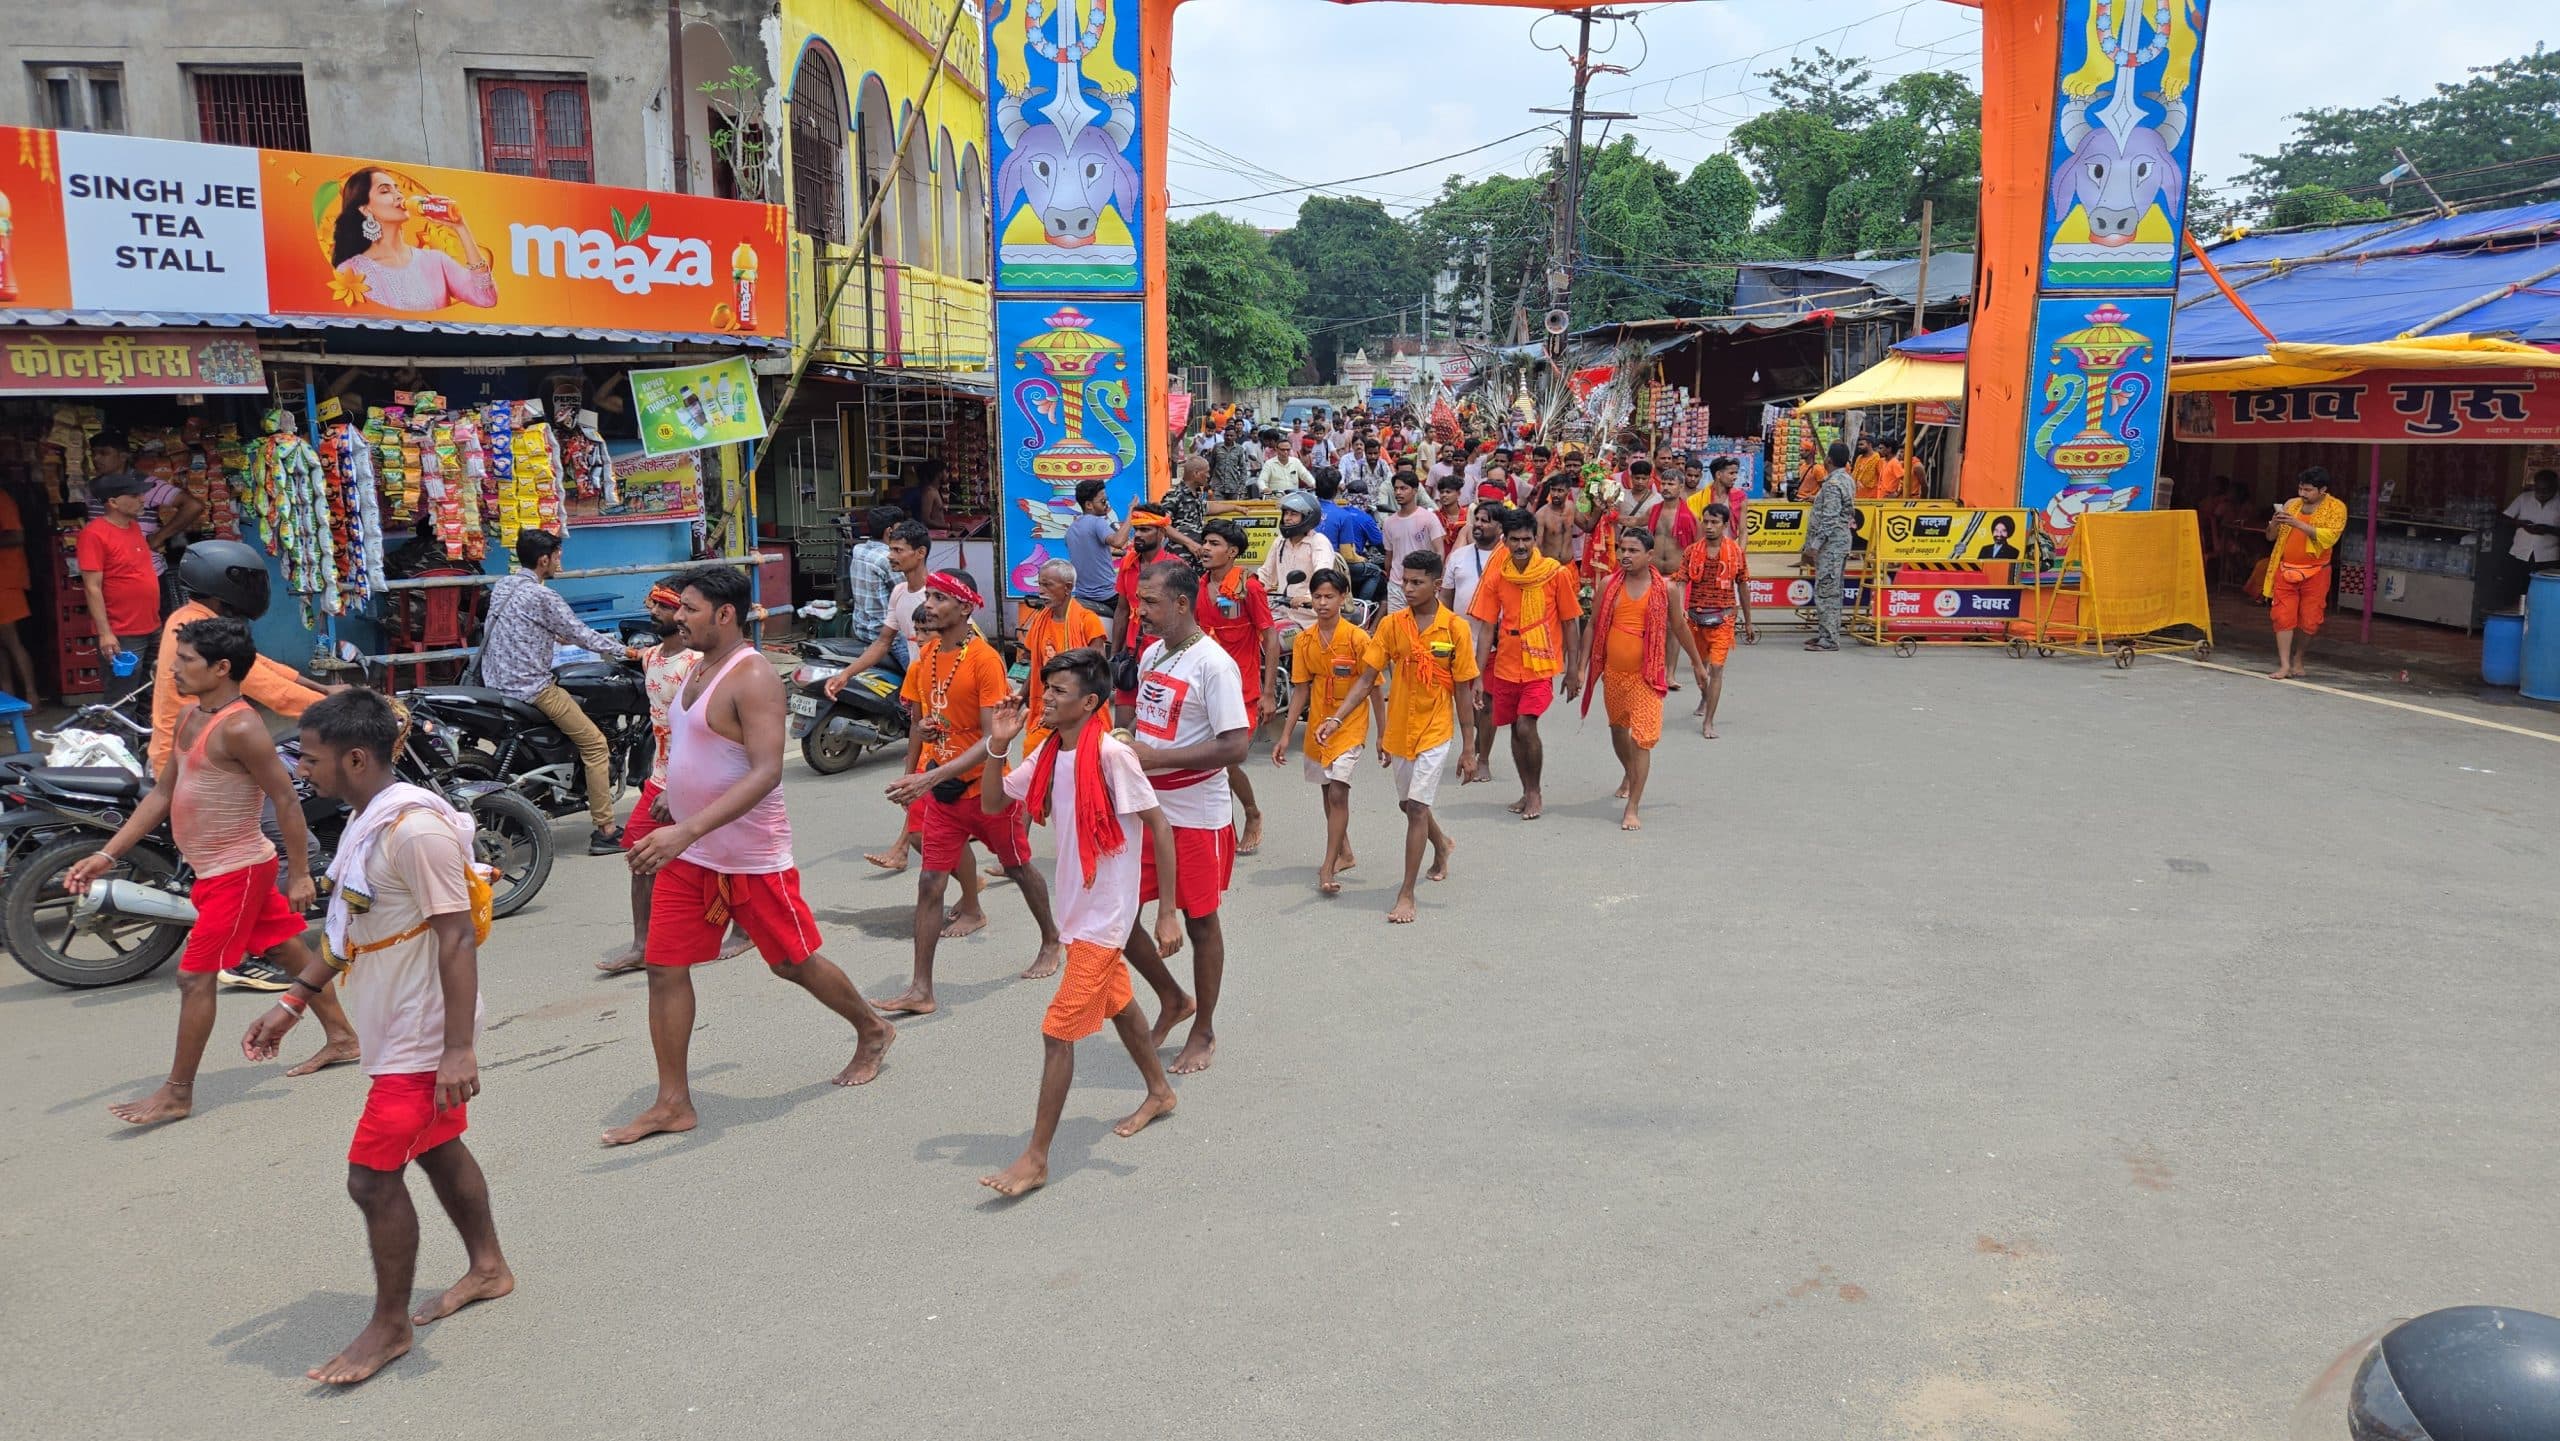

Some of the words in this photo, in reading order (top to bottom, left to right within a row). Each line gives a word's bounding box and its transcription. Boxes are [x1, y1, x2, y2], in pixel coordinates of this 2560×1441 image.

[69, 173, 184, 204] SINGH
[195, 184, 257, 210] JEE
[131, 212, 205, 239] TEA
[116, 245, 226, 273] STALL
[509, 222, 714, 295] maaza
[1971, 594, 2012, 610] देवघर
